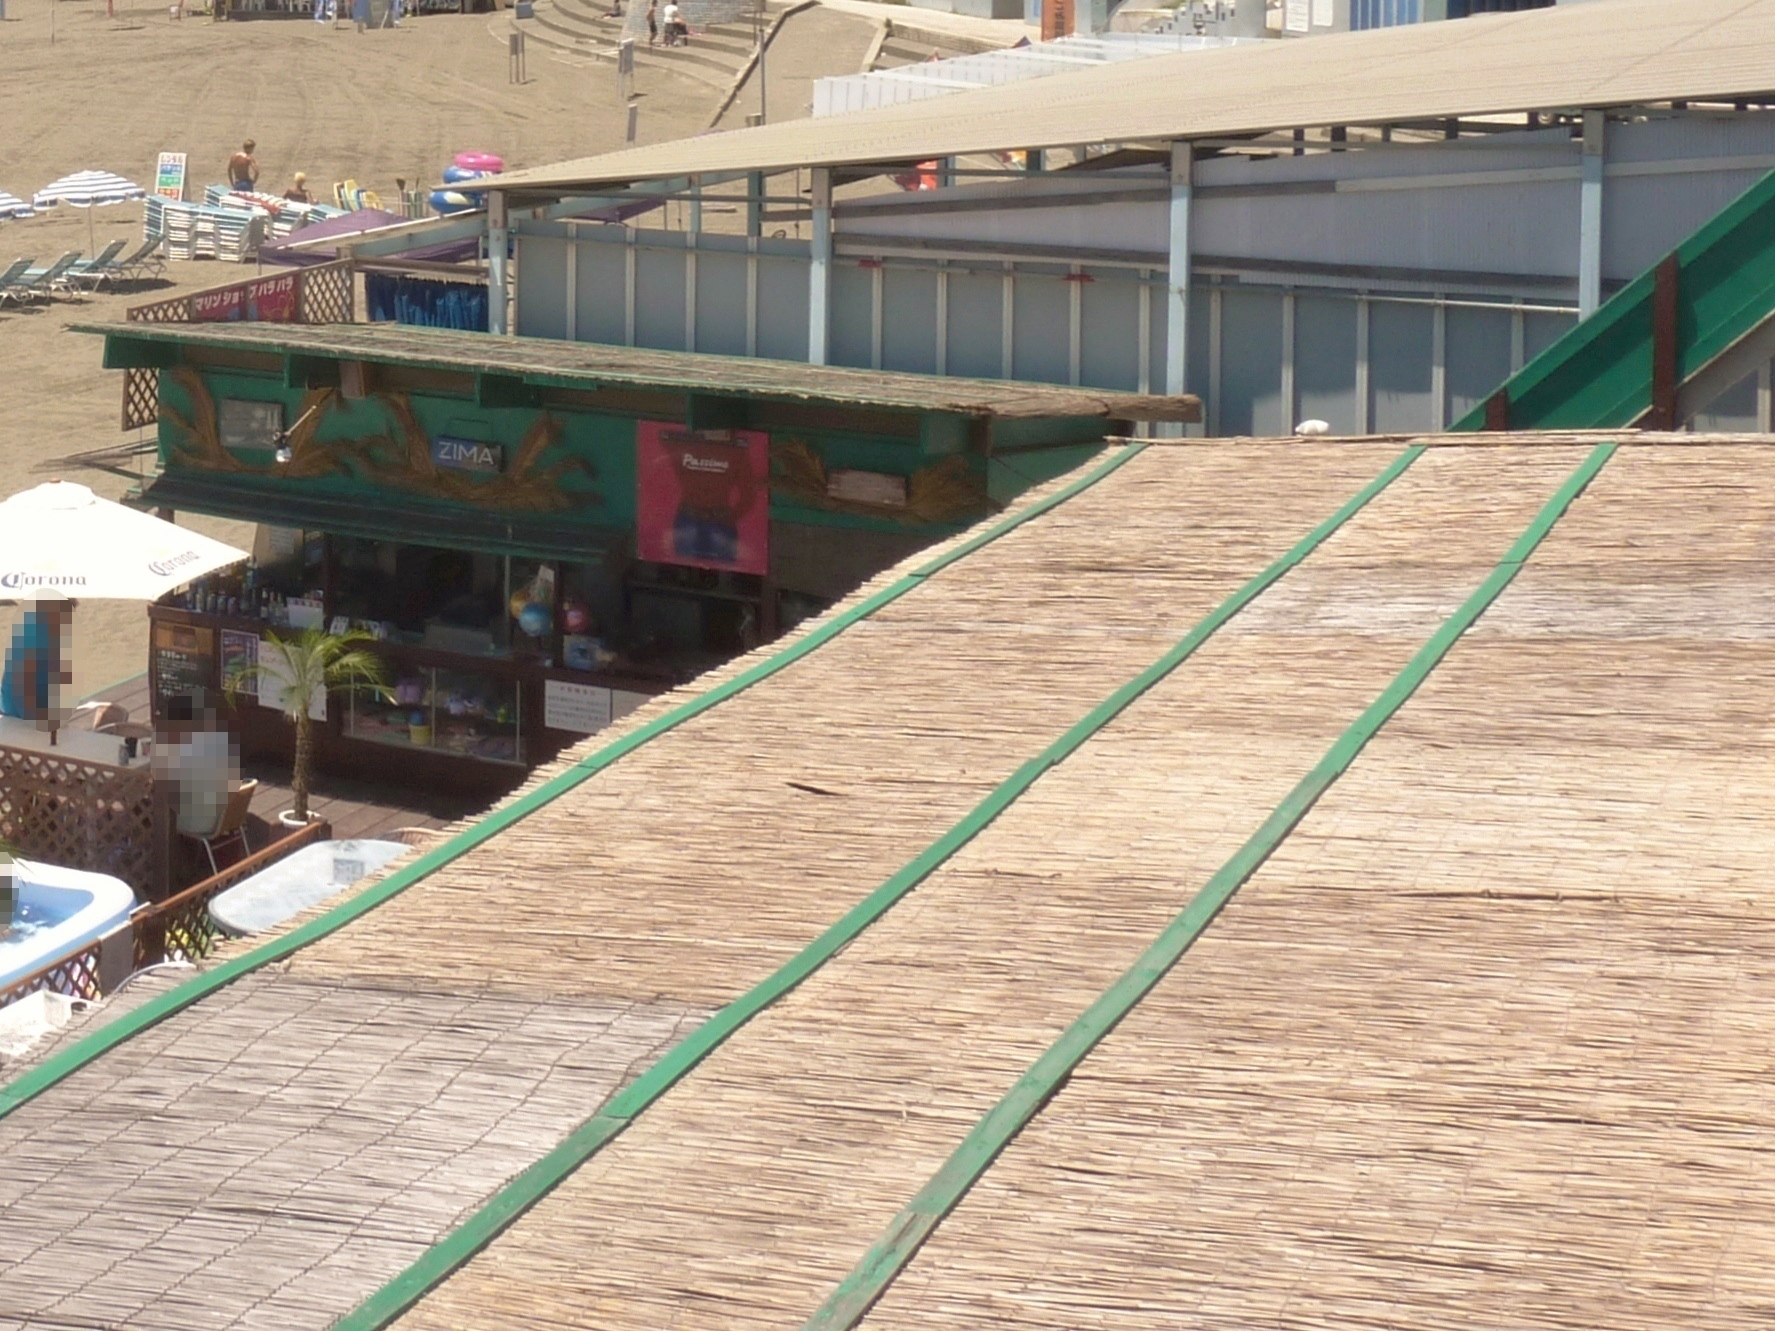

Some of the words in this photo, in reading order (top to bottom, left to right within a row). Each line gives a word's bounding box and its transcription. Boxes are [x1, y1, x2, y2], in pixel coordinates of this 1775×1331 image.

[438, 441, 494, 465] ZIMA
[148, 549, 201, 577] Corona
[1, 571, 87, 591] Corona
